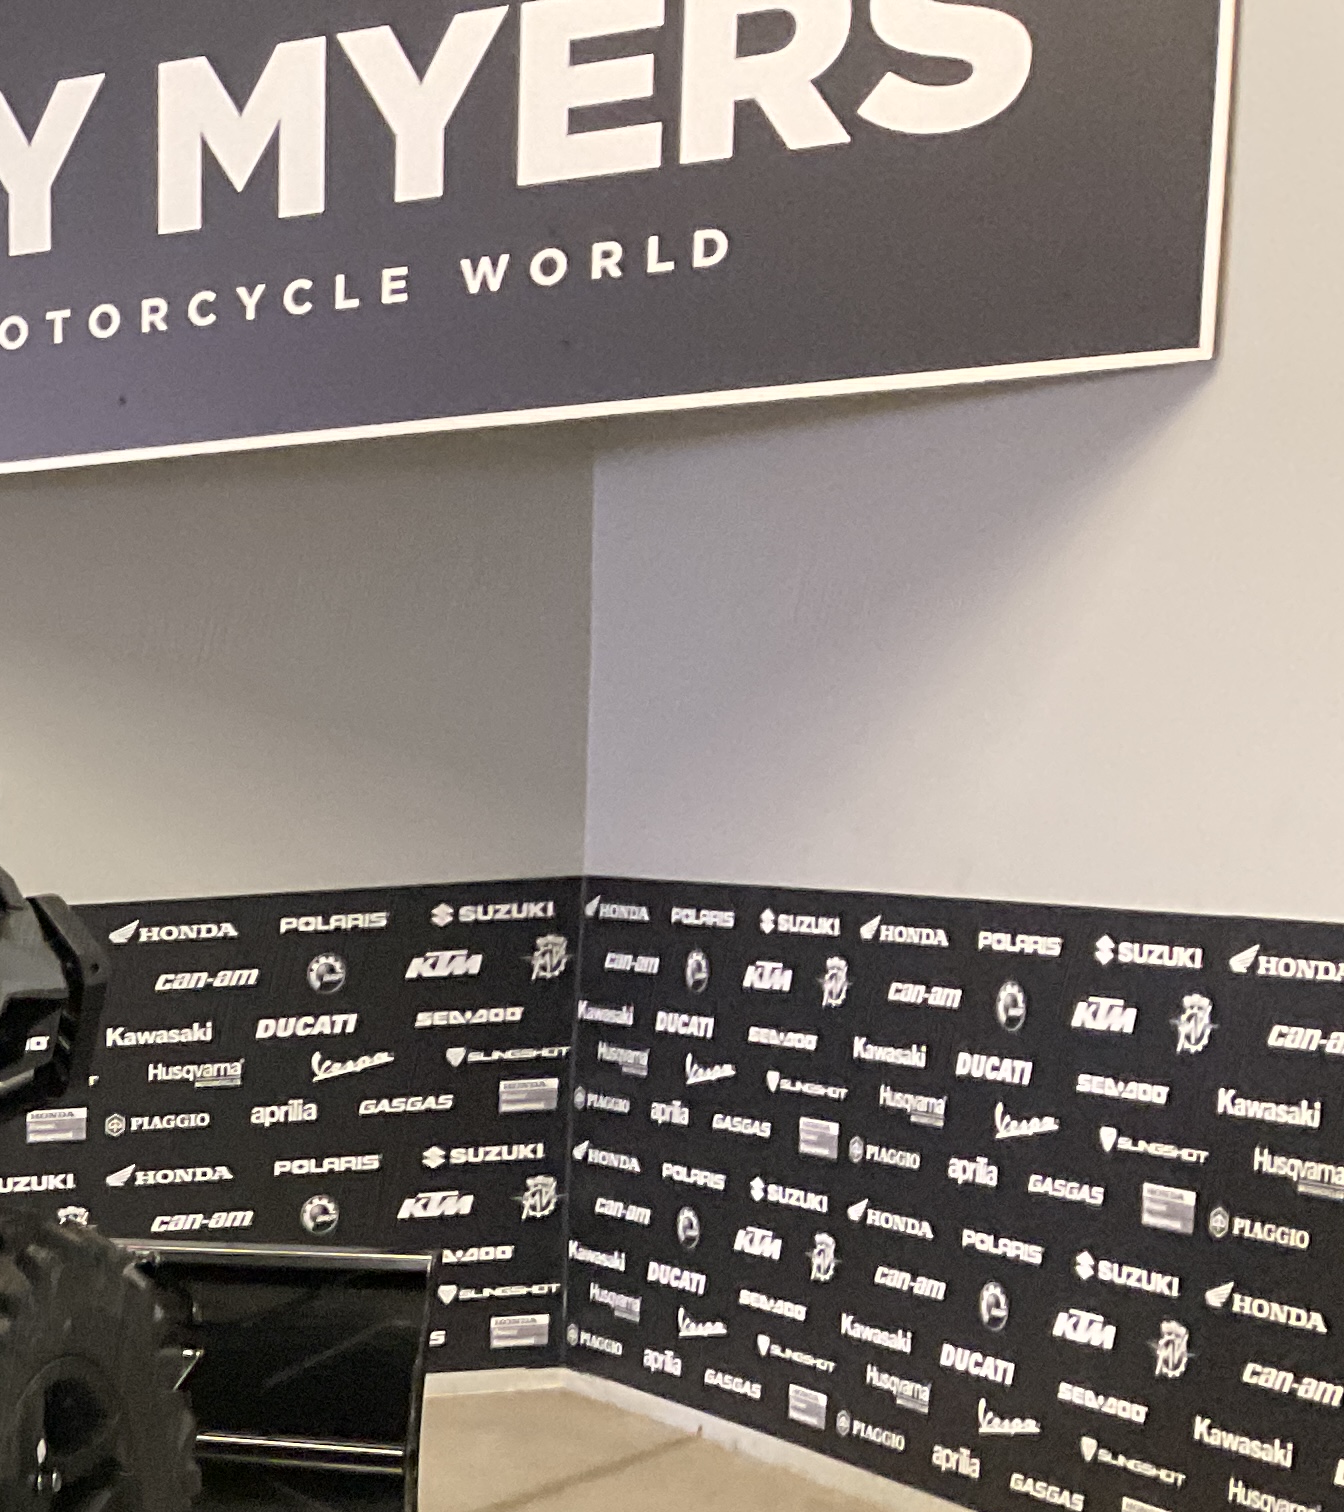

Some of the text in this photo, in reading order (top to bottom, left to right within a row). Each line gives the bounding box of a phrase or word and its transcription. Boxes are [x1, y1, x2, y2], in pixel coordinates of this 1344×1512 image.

[158, 0, 1032, 235] MYERS
[459, 228, 729, 295] WORLD
[280, 912, 389, 934] POLARIS
[459, 901, 554, 921] SUZUKI
[599, 904, 649, 921] HONDA
[671, 907, 735, 928] POLARIS
[778, 914, 840, 936] SUZUKI
[139, 923, 238, 942] HONDA
[879, 925, 949, 947] HONDA
[978, 931, 1063, 957] POLARIS
[405, 950, 482, 978] KTM
[605, 952, 659, 973] can-am
[1118, 942, 1203, 969] SUZUKI
[155, 969, 259, 992] can-am
[743, 961, 792, 992] KTM
[888, 982, 962, 1009] can-am
[256, 1013, 357, 1039] DUCATI
[655, 1011, 714, 1039] DUCATI
[1071, 996, 1137, 1034] KTM
[106, 1022, 212, 1047] Kawasaki
[1267, 1023, 1344, 1056] can-a
[468, 1046, 571, 1061] SLINGSHOT
[853, 1036, 926, 1068] Kawasaki
[148, 1060, 241, 1081] Husqvarna
[311, 1051, 394, 1082] Vespa
[955, 1052, 1032, 1086] DUCATI
[251, 1099, 317, 1128] aprilia
[359, 1095, 454, 1116] GASGAS
[587, 1093, 630, 1113] PIAGGIO
[651, 1100, 689, 1125] aprilia
[1216, 1088, 1321, 1128] Kawasaki
[131, 1113, 210, 1132] PIAGGIO
[712, 1114, 771, 1138] GASGAS
[994, 1102, 1059, 1139] Vespa
[450, 1143, 545, 1164] SUZUKI
[588, 1149, 640, 1173] HONDA
[866, 1144, 920, 1169] PIAGGIO
[1118, 1137, 1209, 1163] SLINGSHOT
[135, 1166, 233, 1186] HONDA
[274, 1155, 382, 1176] POLARIS
[662, 1162, 726, 1191] POLARIS
[948, 1156, 998, 1187] aprilia
[767, 1184, 828, 1213] SUZUKI
[1028, 1174, 1104, 1206] GASGAS
[397, 1190, 474, 1219] KTM
[595, 1198, 651, 1225] can-am
[151, 1211, 254, 1233] can-am
[866, 1209, 934, 1240] HONDA
[1232, 1216, 1309, 1249] PIAGGIO
[733, 1226, 782, 1260] KTM
[962, 1229, 1044, 1265] POLARIS
[459, 1283, 561, 1300] SLINGSHOT
[647, 1261, 706, 1295] DUCATI
[874, 1265, 946, 1300] can-am
[1098, 1260, 1180, 1298] SUZUKI
[1232, 1293, 1327, 1334] HONDA
[580, 1330, 622, 1355] PIAGGIO
[841, 1313, 912, 1354] Kawasaki
[1052, 1308, 1116, 1350] KTM
[643, 1349, 682, 1376] aprilia
[940, 1343, 1015, 1387] DUCATI
[704, 1368, 761, 1399] GASGAS
[1242, 1362, 1344, 1407] can-am
[978, 1398, 1040, 1436] Vespa
[852, 1420, 905, 1451] PIAGGIO
[1194, 1415, 1293, 1468] Kawasaki
[932, 1444, 980, 1480] aprilia
[1010, 1472, 1084, 1512] GASGAS
